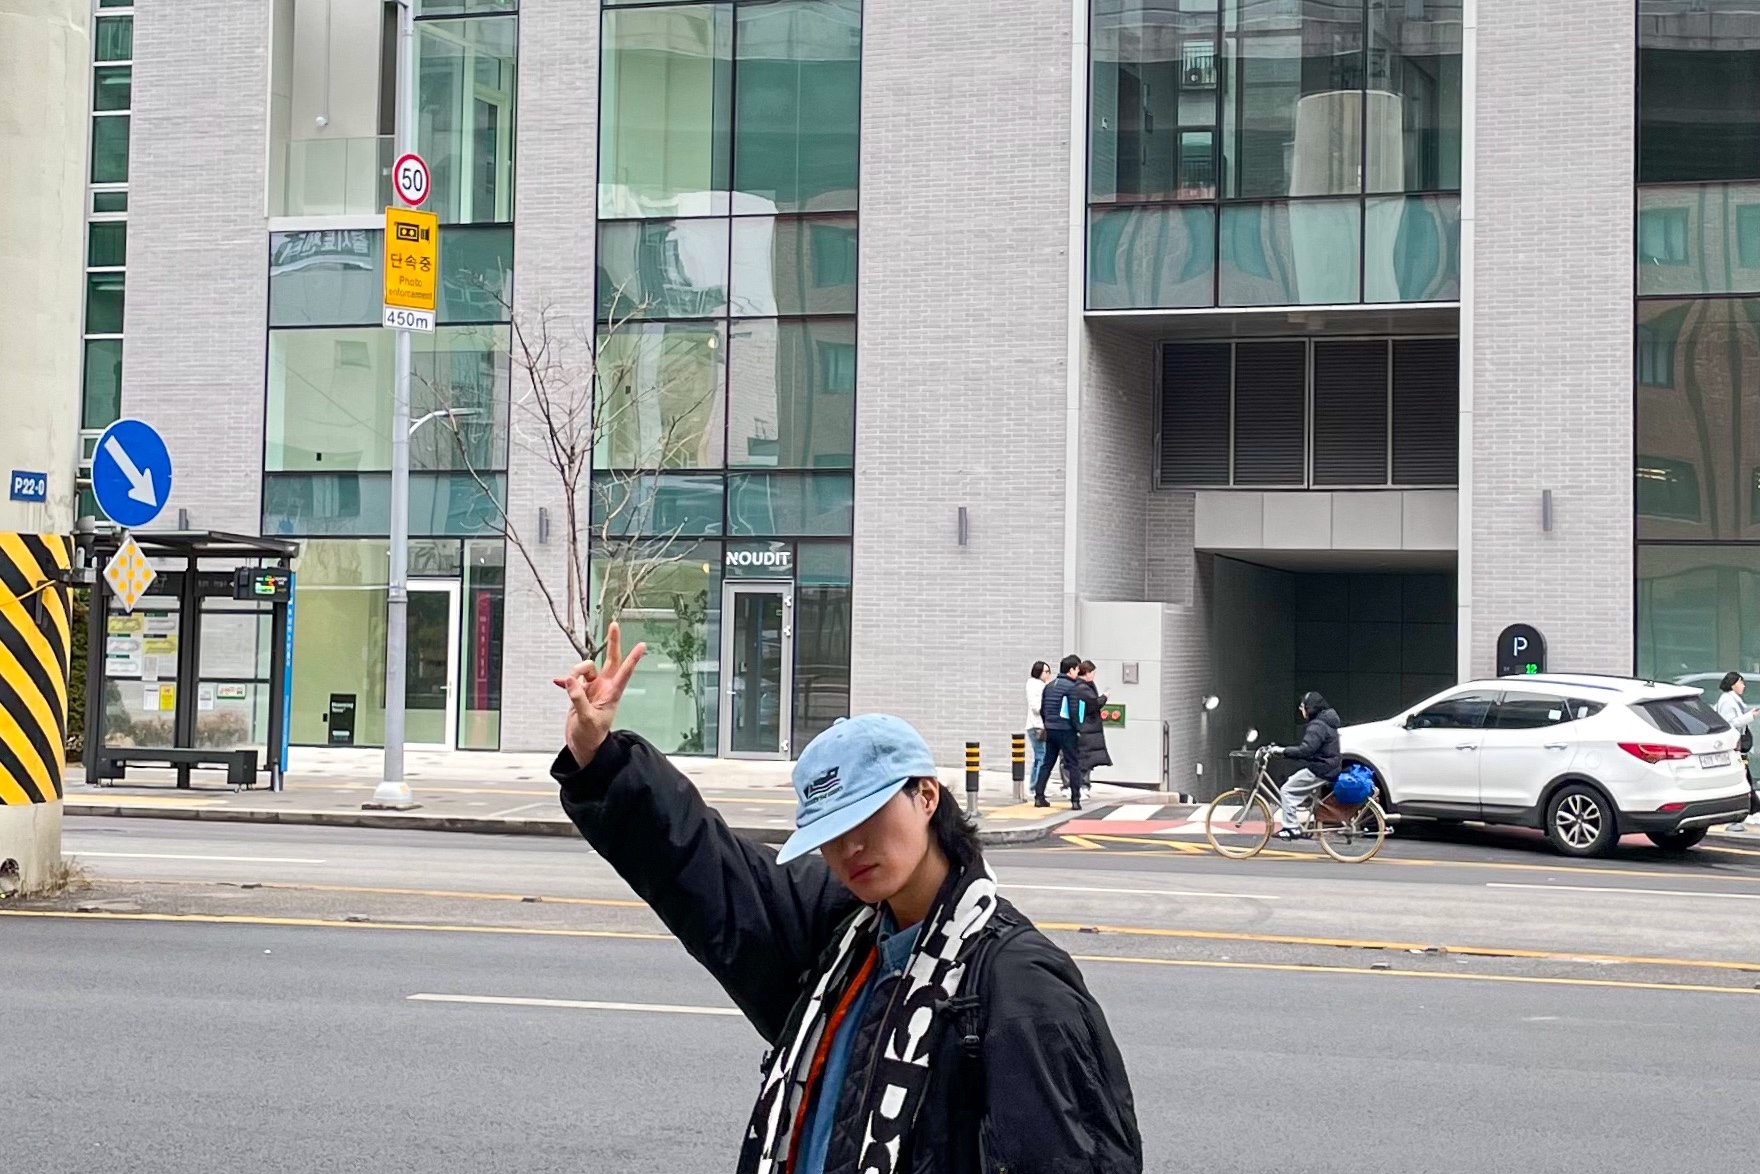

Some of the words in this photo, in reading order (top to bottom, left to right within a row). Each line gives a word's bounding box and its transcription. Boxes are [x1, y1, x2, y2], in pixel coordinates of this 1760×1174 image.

[402, 167, 423, 191] 50
[390, 252, 432, 272] 단속중
[399, 275, 423, 288] Photo
[387, 310, 428, 329] 450m
[14, 476, 45, 496] P22-0
[725, 551, 791, 566] NOUDIT
[1513, 636, 1528, 657] P
